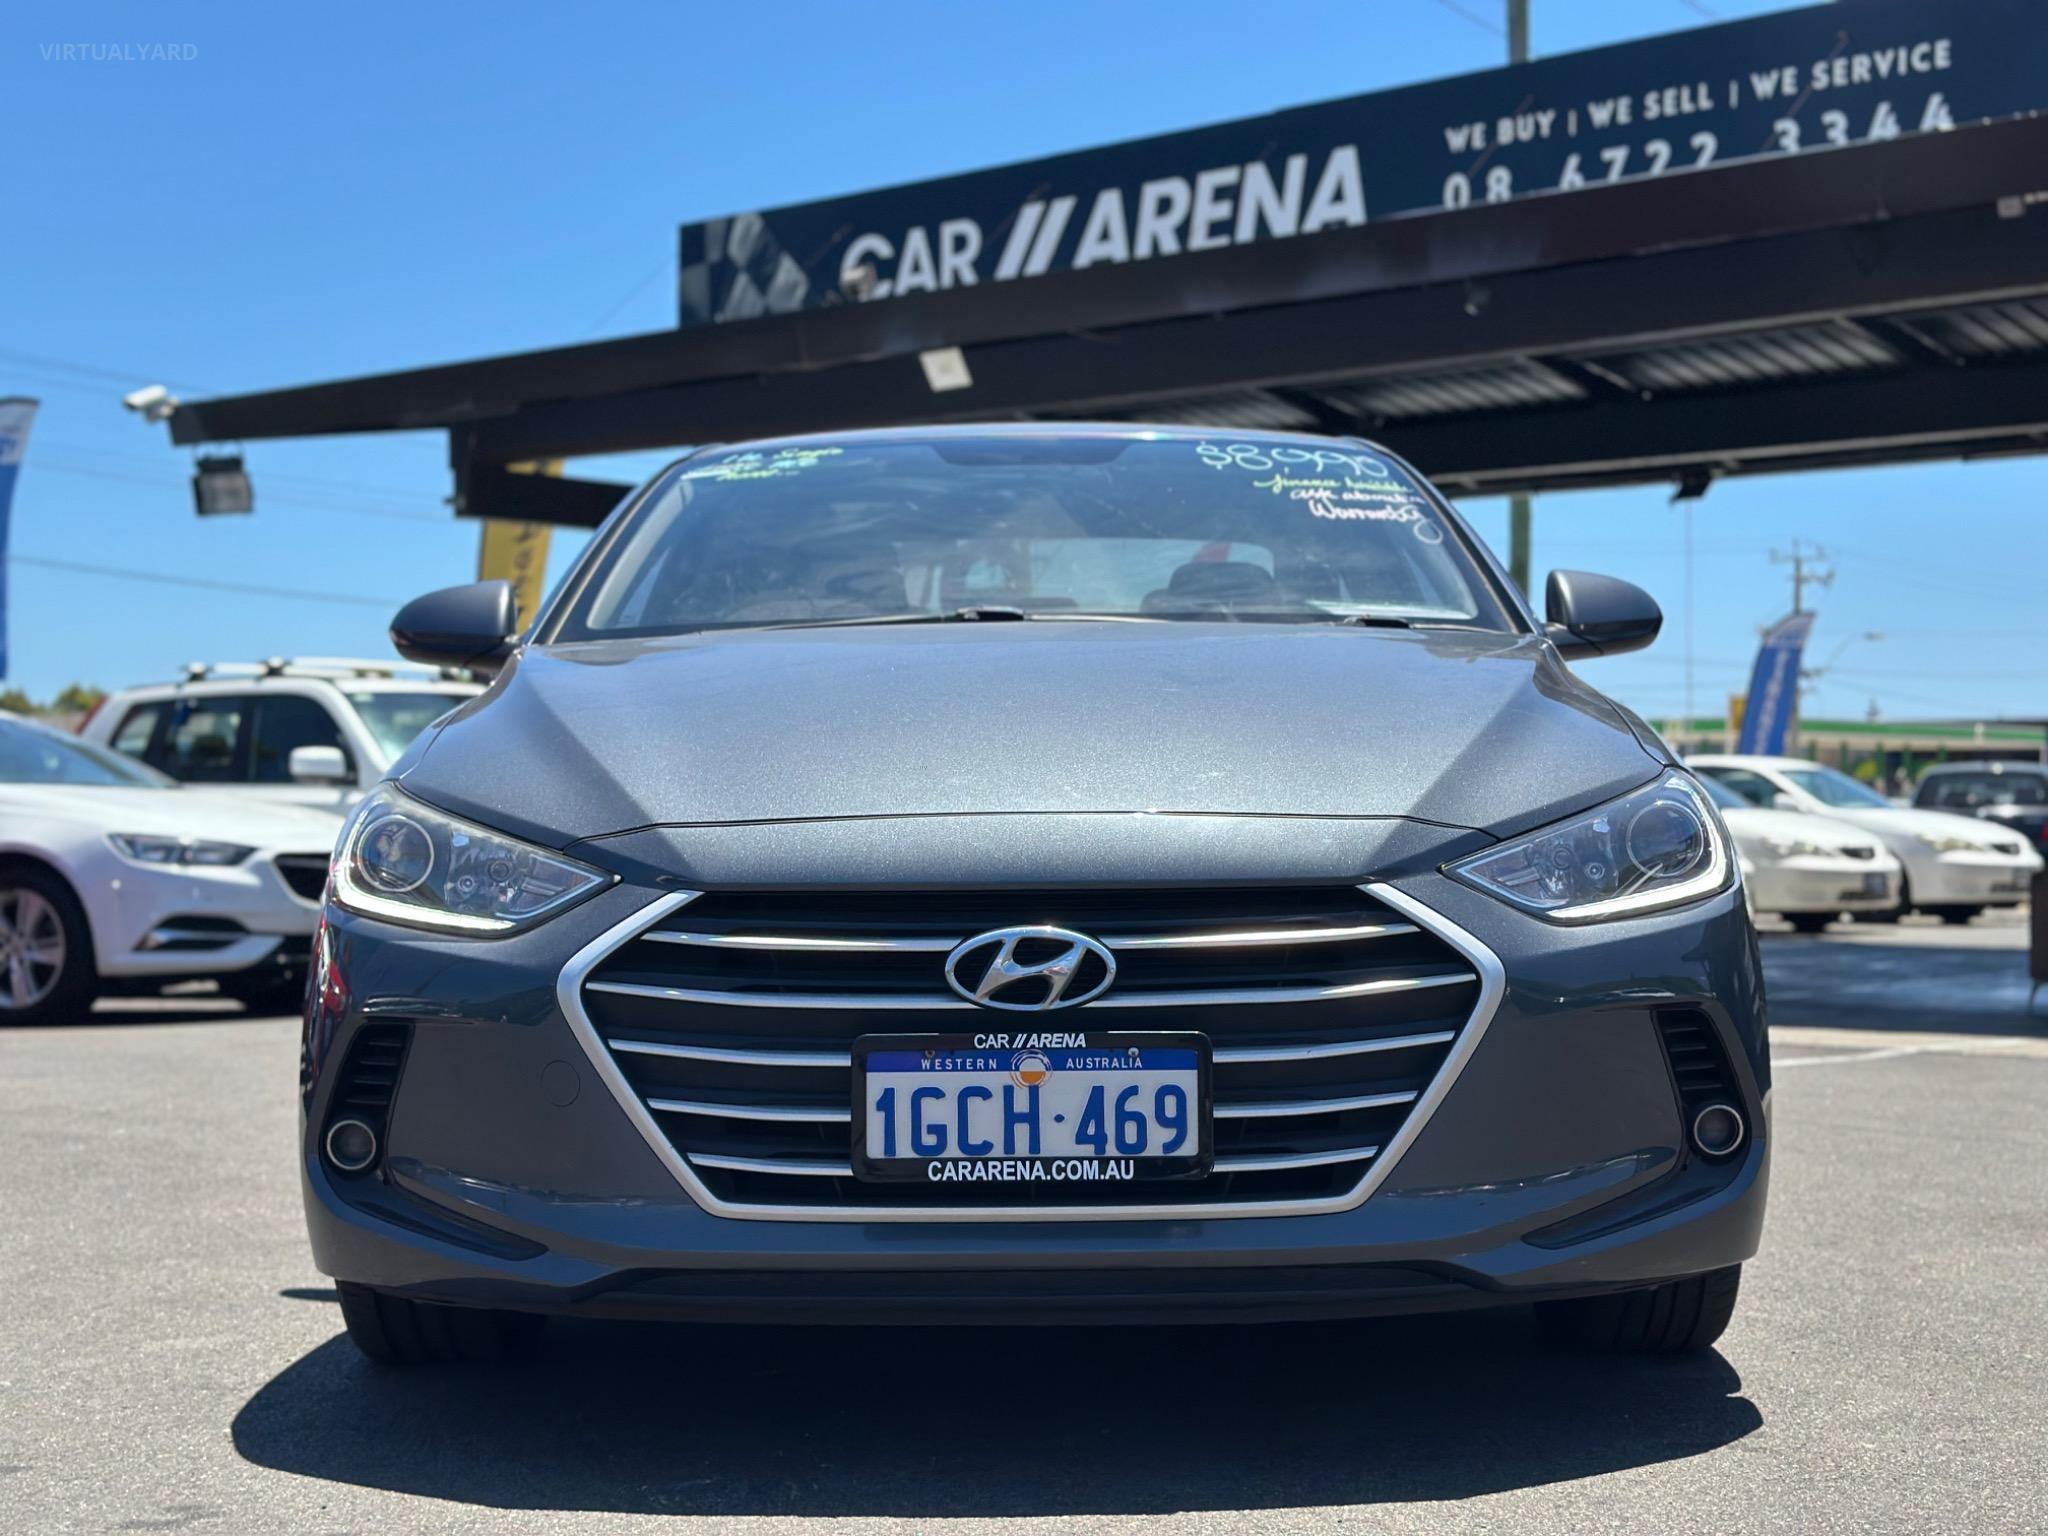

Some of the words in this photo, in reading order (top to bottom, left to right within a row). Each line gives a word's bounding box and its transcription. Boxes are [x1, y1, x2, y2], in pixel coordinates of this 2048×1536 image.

[1444, 121, 1487, 154] WE
[1496, 109, 1556, 146] BUY
[1587, 96, 1632, 129] WE
[1643, 81, 1715, 120] SELL
[1750, 66, 1799, 101] WE
[1811, 38, 1952, 91] SERVICE
[840, 217, 983, 302] CAR
[974, 1034, 1009, 1049] CAR
[920, 1058, 998, 1071] WESTERN
[1065, 1056, 1143, 1070] AUSTRALIA
[927, 1159, 1135, 1182] CARARENA.COM.AU
